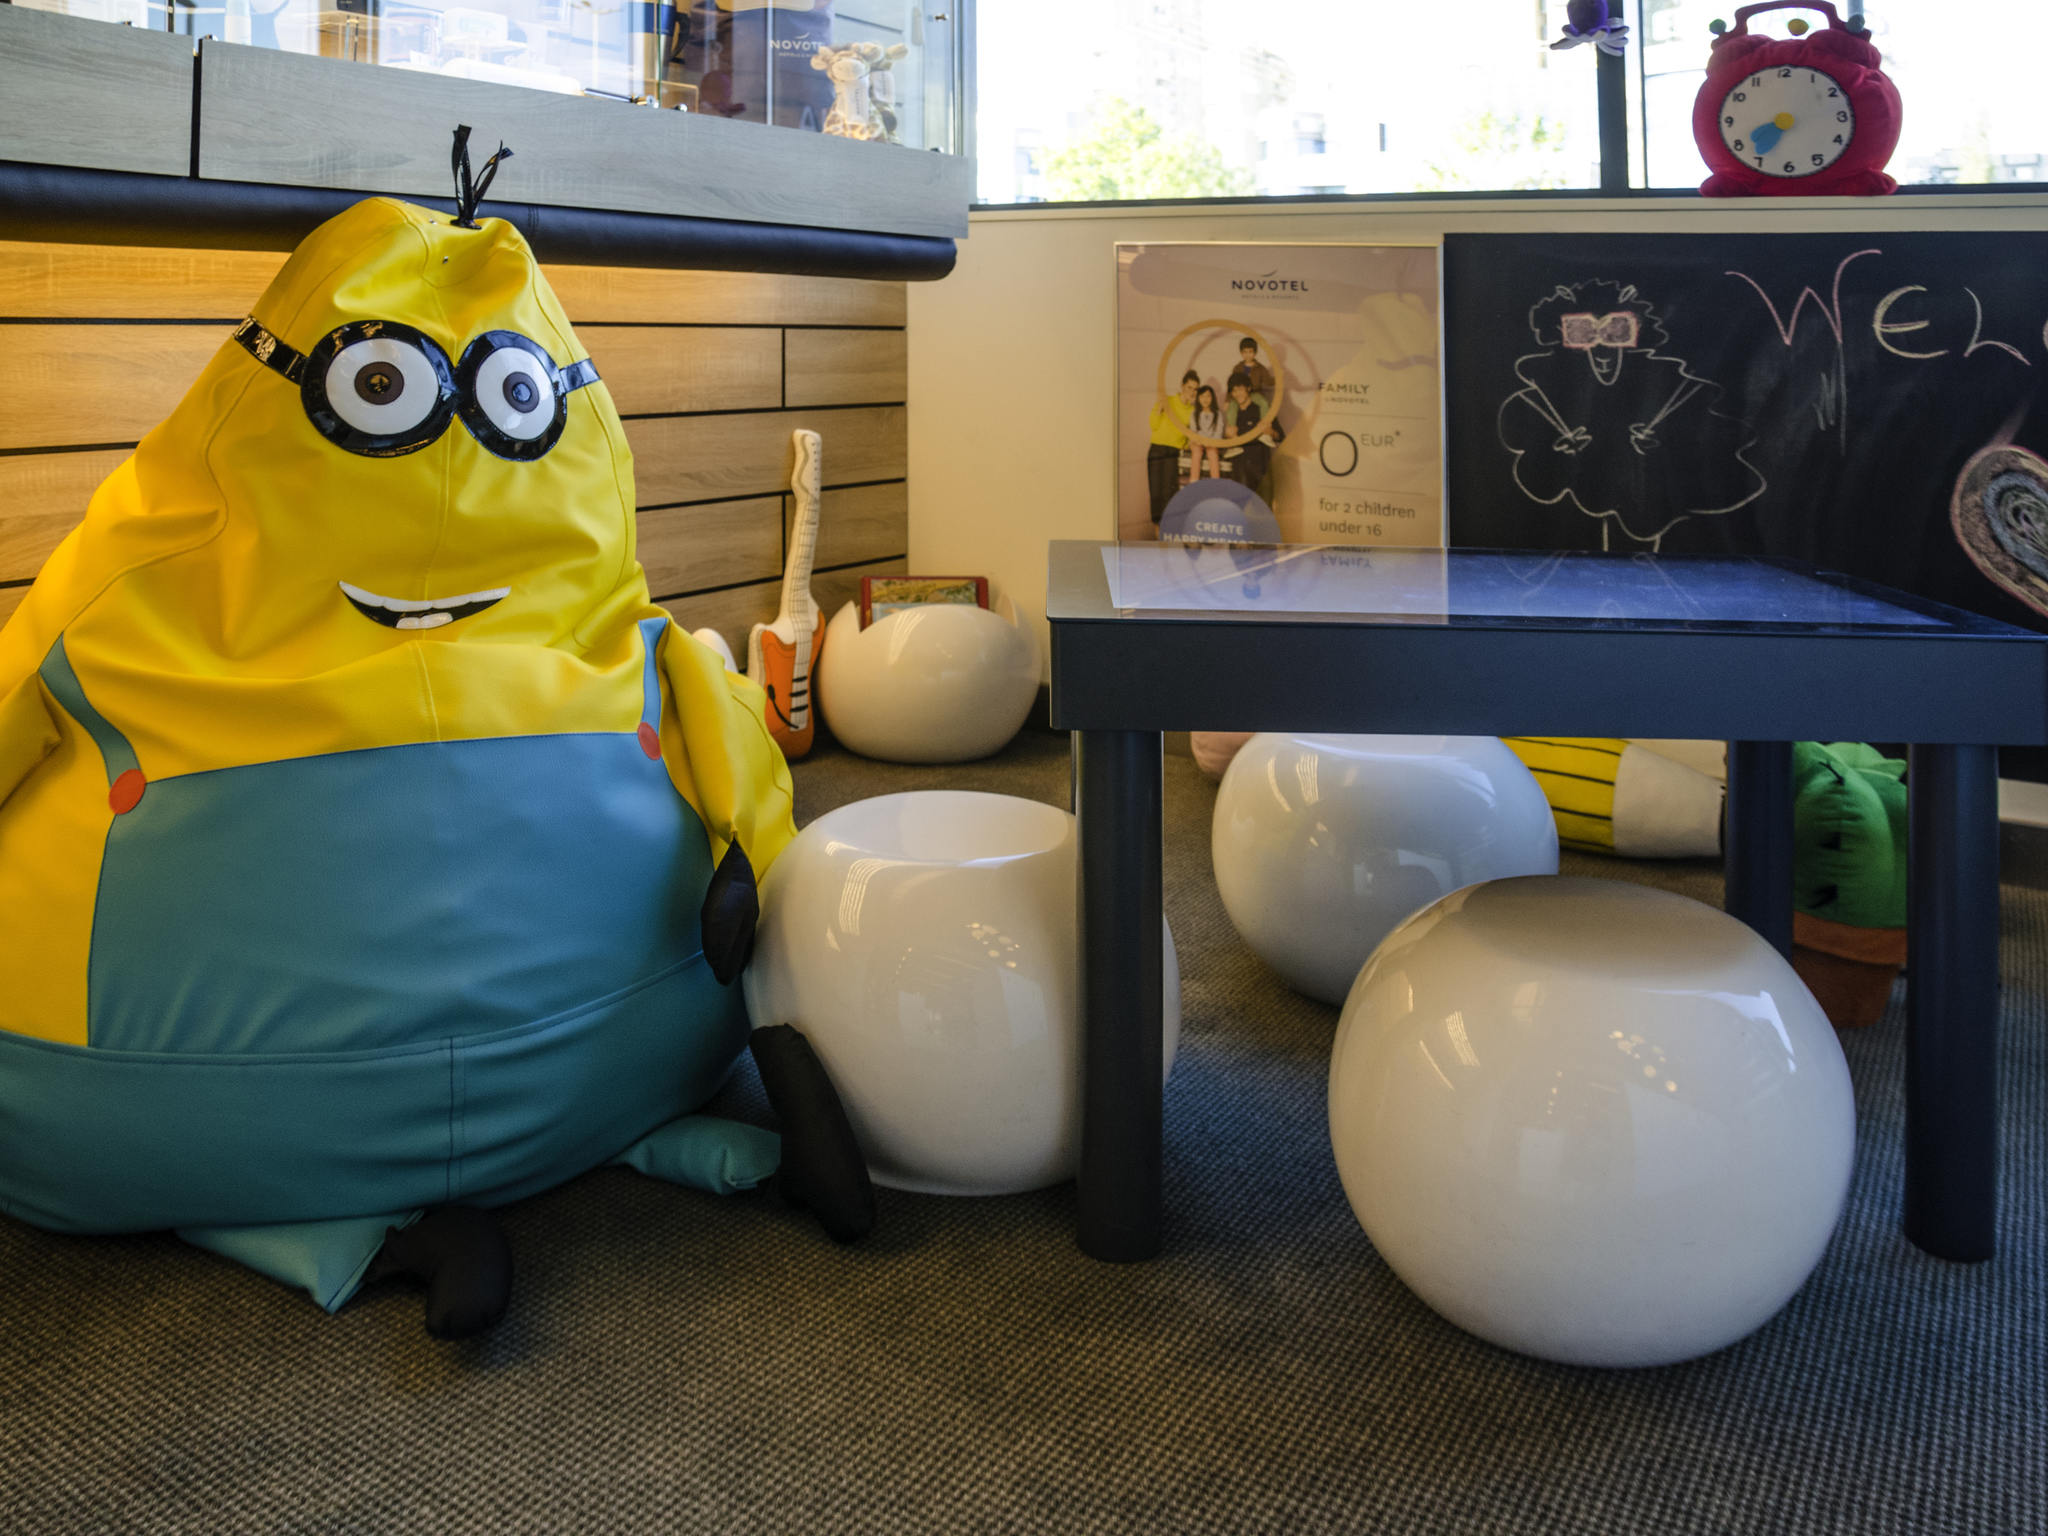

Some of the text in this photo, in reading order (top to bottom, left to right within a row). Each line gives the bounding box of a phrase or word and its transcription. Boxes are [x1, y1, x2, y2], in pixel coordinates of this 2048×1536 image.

[1778, 68, 1792, 79] 12
[1811, 73, 1815, 83] 1
[1752, 77, 1760, 87] 11
[1733, 92, 1746, 102] 10
[1828, 87, 1838, 98] 2
[1724, 115, 1734, 127] 9
[1836, 110, 1848, 123] 3
[1733, 139, 1744, 151] 8
[1832, 134, 1843, 146] 4
[1754, 156, 1763, 167] 7
[1811, 153, 1823, 167] 5
[1784, 161, 1795, 173] 6
[1231, 279, 1309, 291] NOVOTEL
[1725, 249, 2048, 366] WEL
[1318, 382, 1370, 394] FAMILY
[1319, 497, 1416, 519] for 2 children
[1195, 521, 1244, 536] CREATE
[1319, 520, 1382, 537] under 16
